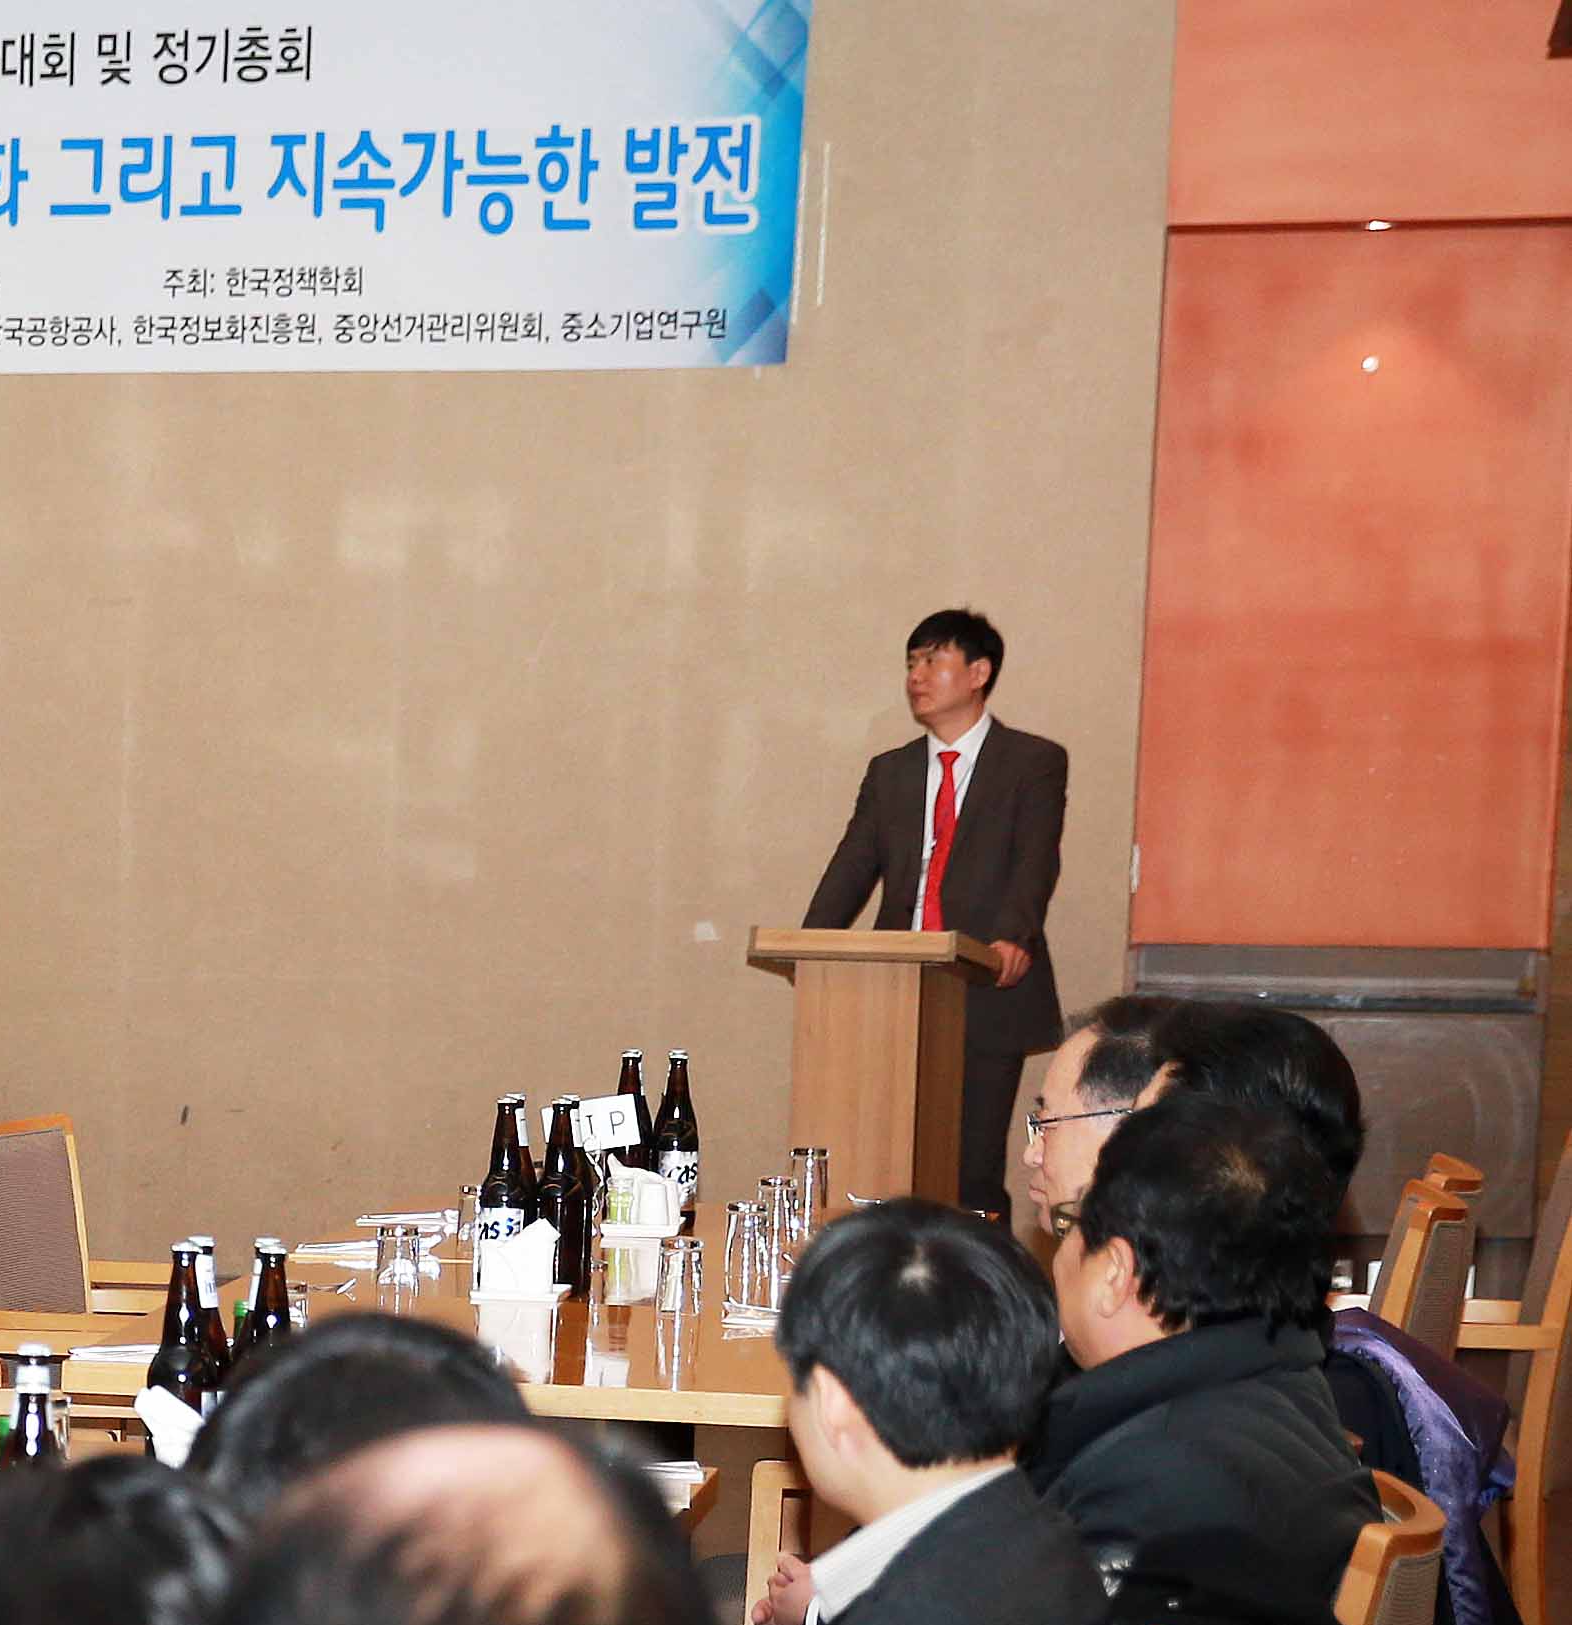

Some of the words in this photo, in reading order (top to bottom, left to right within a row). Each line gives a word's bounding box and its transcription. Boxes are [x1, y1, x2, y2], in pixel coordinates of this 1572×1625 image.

[97, 30, 132, 86] 및
[152, 25, 313, 85] 정기총회
[49, 135, 243, 221] 그리고
[267, 124, 600, 234] 지속가능한
[625, 123, 754, 230] 발전
[163, 267, 215, 298] 주최:
[227, 266, 363, 297] 한국정책학회
[134, 313, 322, 345] 한국정보화진흥원,
[333, 312, 550, 345] 중앙선거관리위원회,
[561, 308, 728, 343] 중소기업연구원
[585, 1110, 625, 1136] IP
